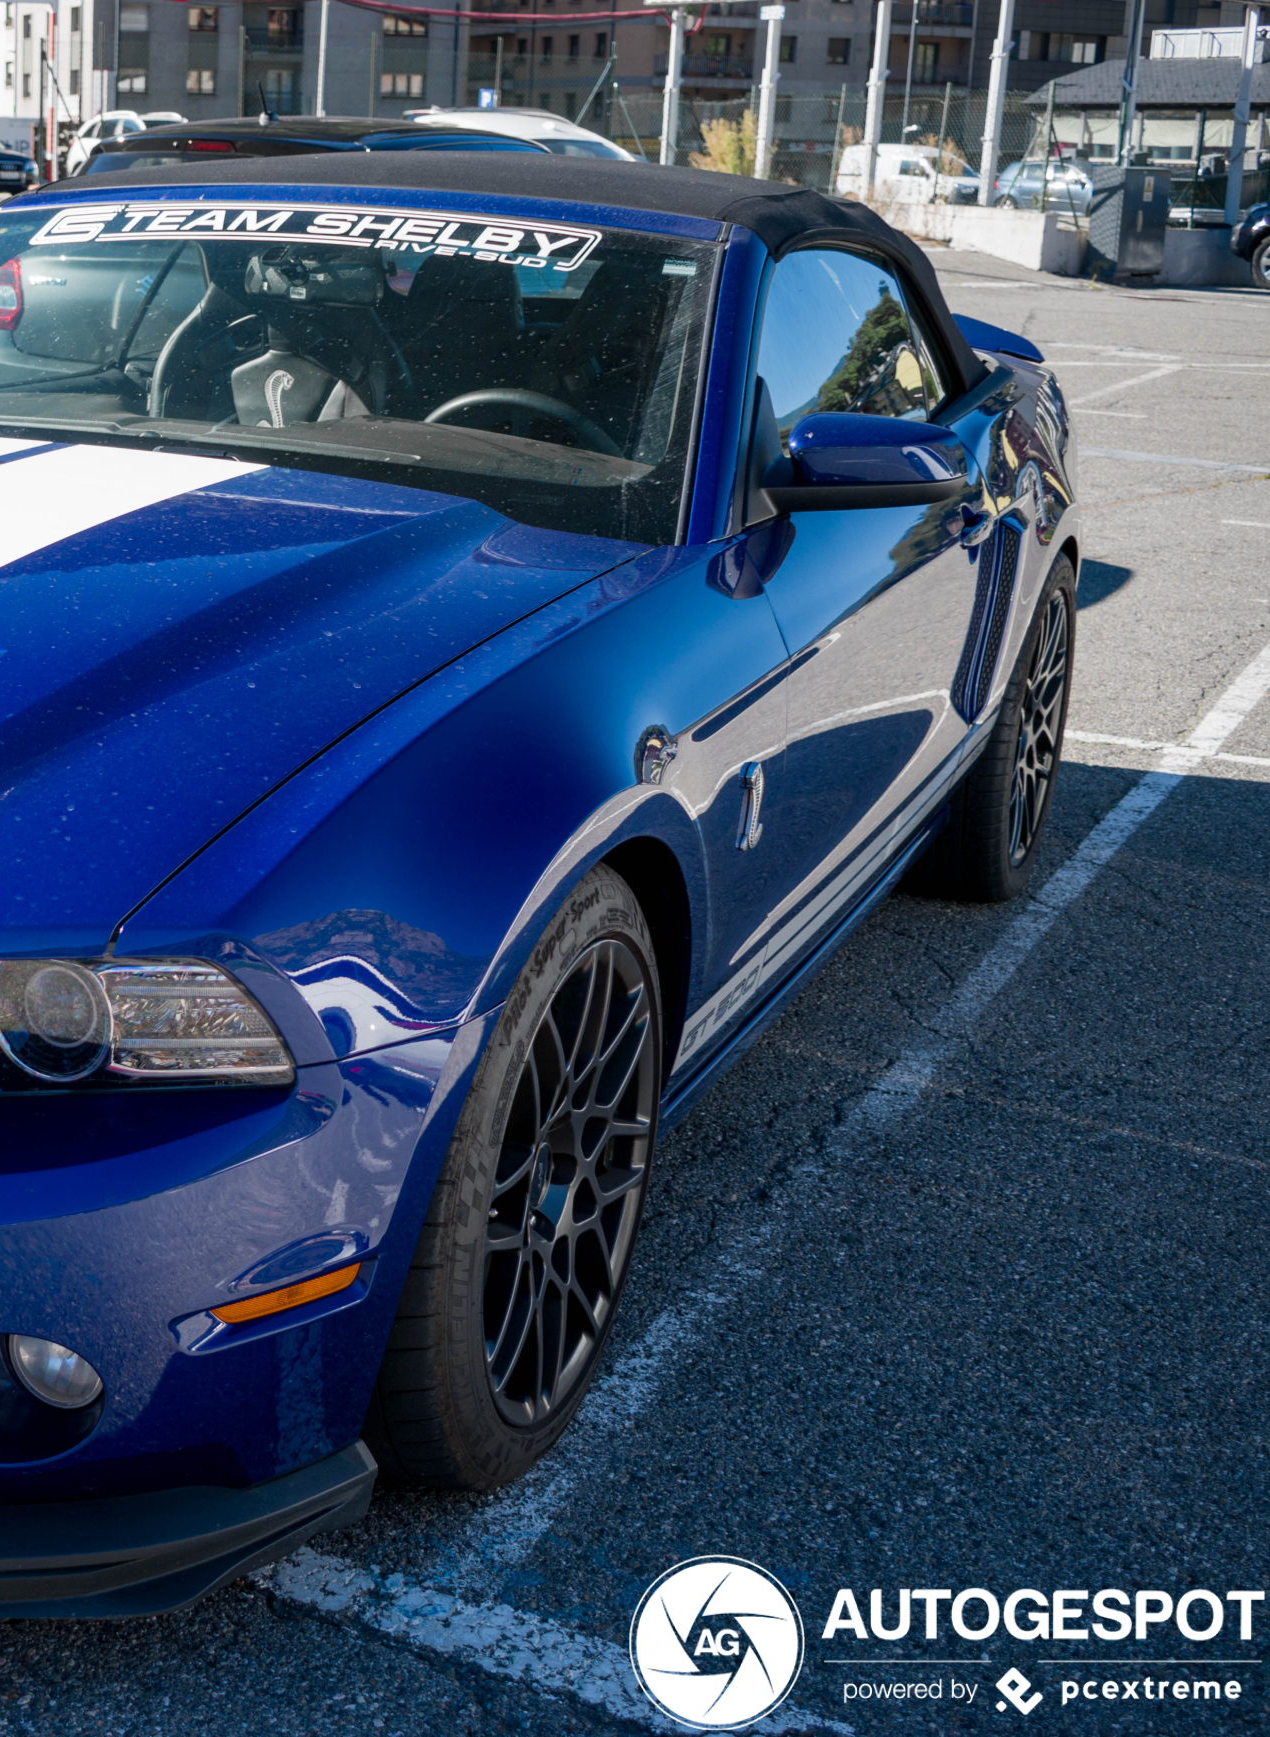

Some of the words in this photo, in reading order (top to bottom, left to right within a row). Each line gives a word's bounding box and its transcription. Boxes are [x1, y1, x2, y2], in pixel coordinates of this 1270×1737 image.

[121, 210, 294, 232] TEAM
[306, 213, 579, 258] SHELBY
[373, 239, 547, 268] RIVE-SUD
[533, 917, 567, 979] Super
[569, 887, 600, 924] Sport
[680, 1007, 716, 1057] GT
[713, 965, 760, 1026] 500
